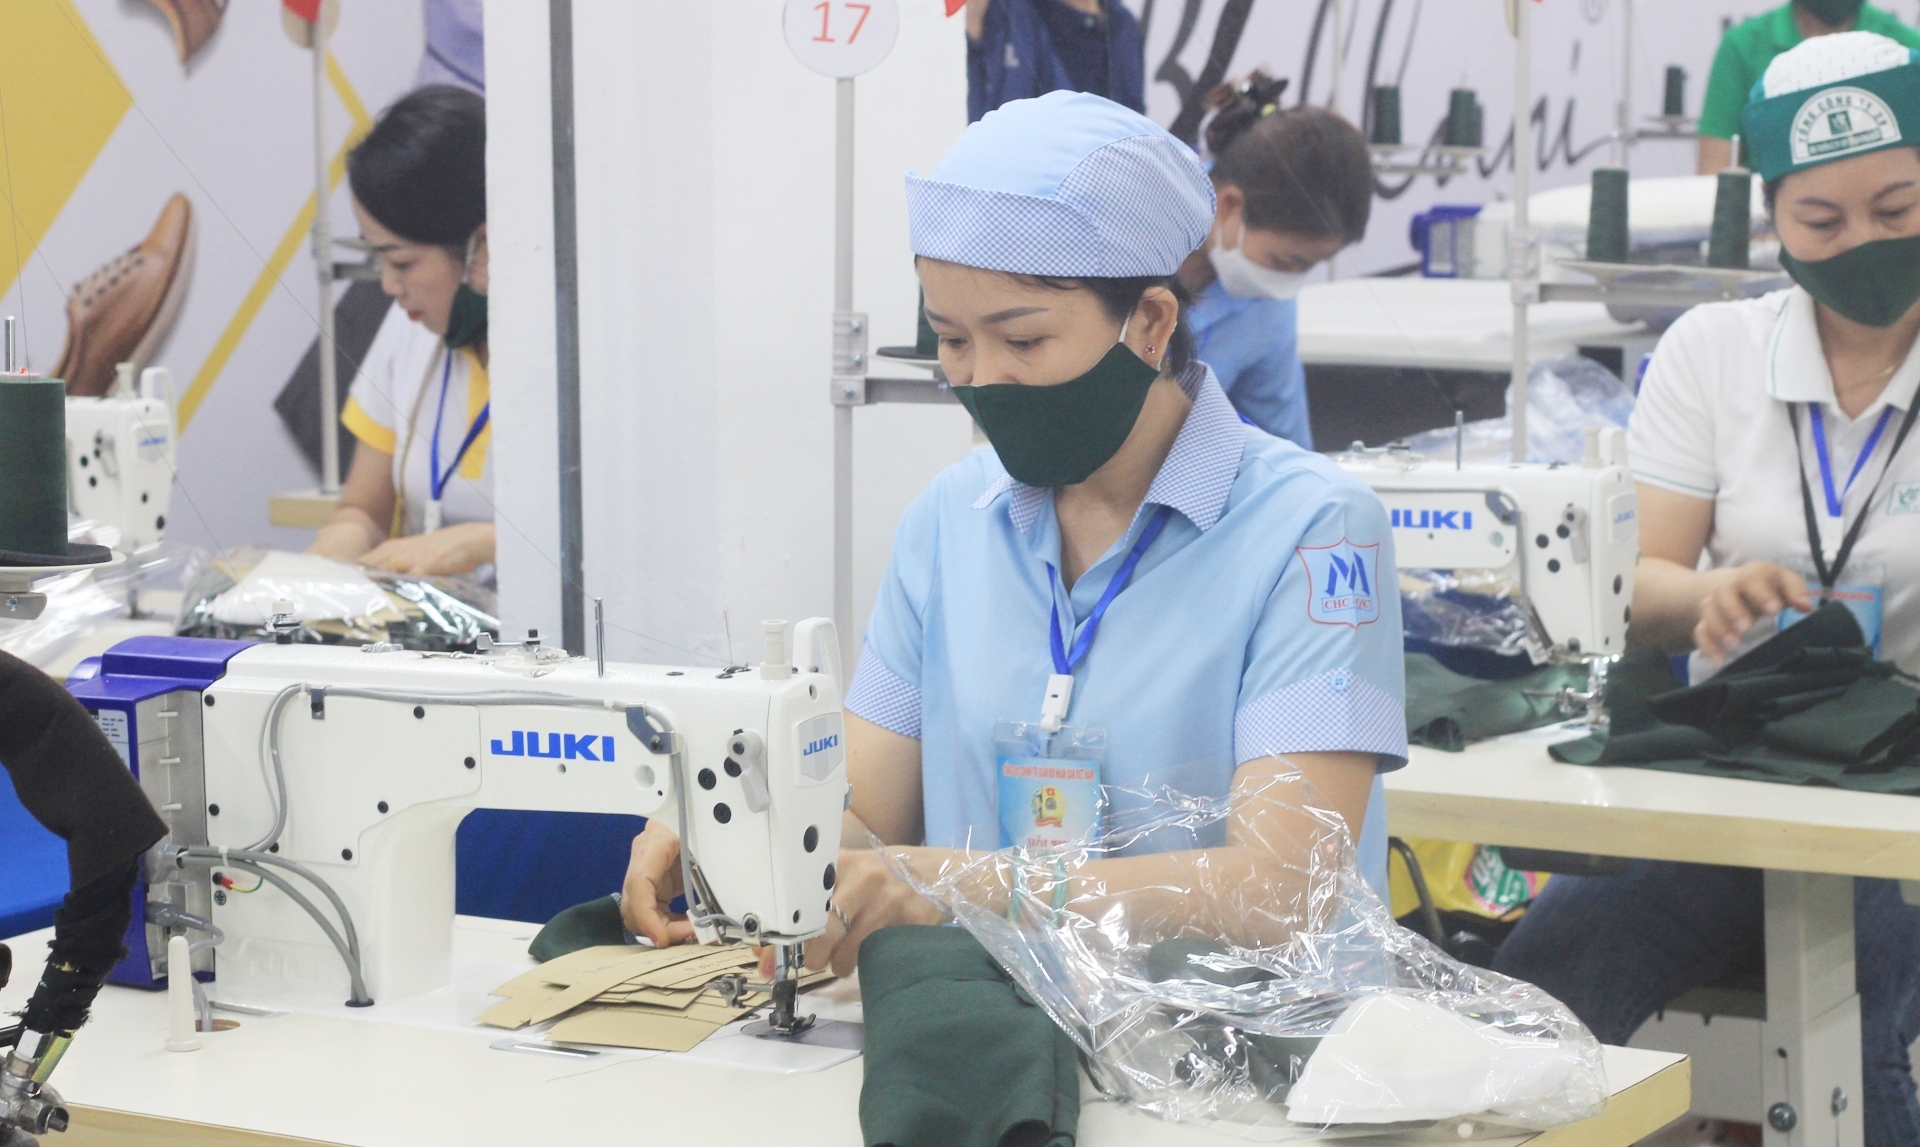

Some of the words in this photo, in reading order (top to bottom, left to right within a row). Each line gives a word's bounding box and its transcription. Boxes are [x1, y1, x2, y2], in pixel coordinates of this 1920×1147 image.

[812, 1, 871, 44] 17
[1324, 598, 1350, 609] CHC
[491, 730, 615, 762] JUKI
[803, 734, 838, 756] JUKI
